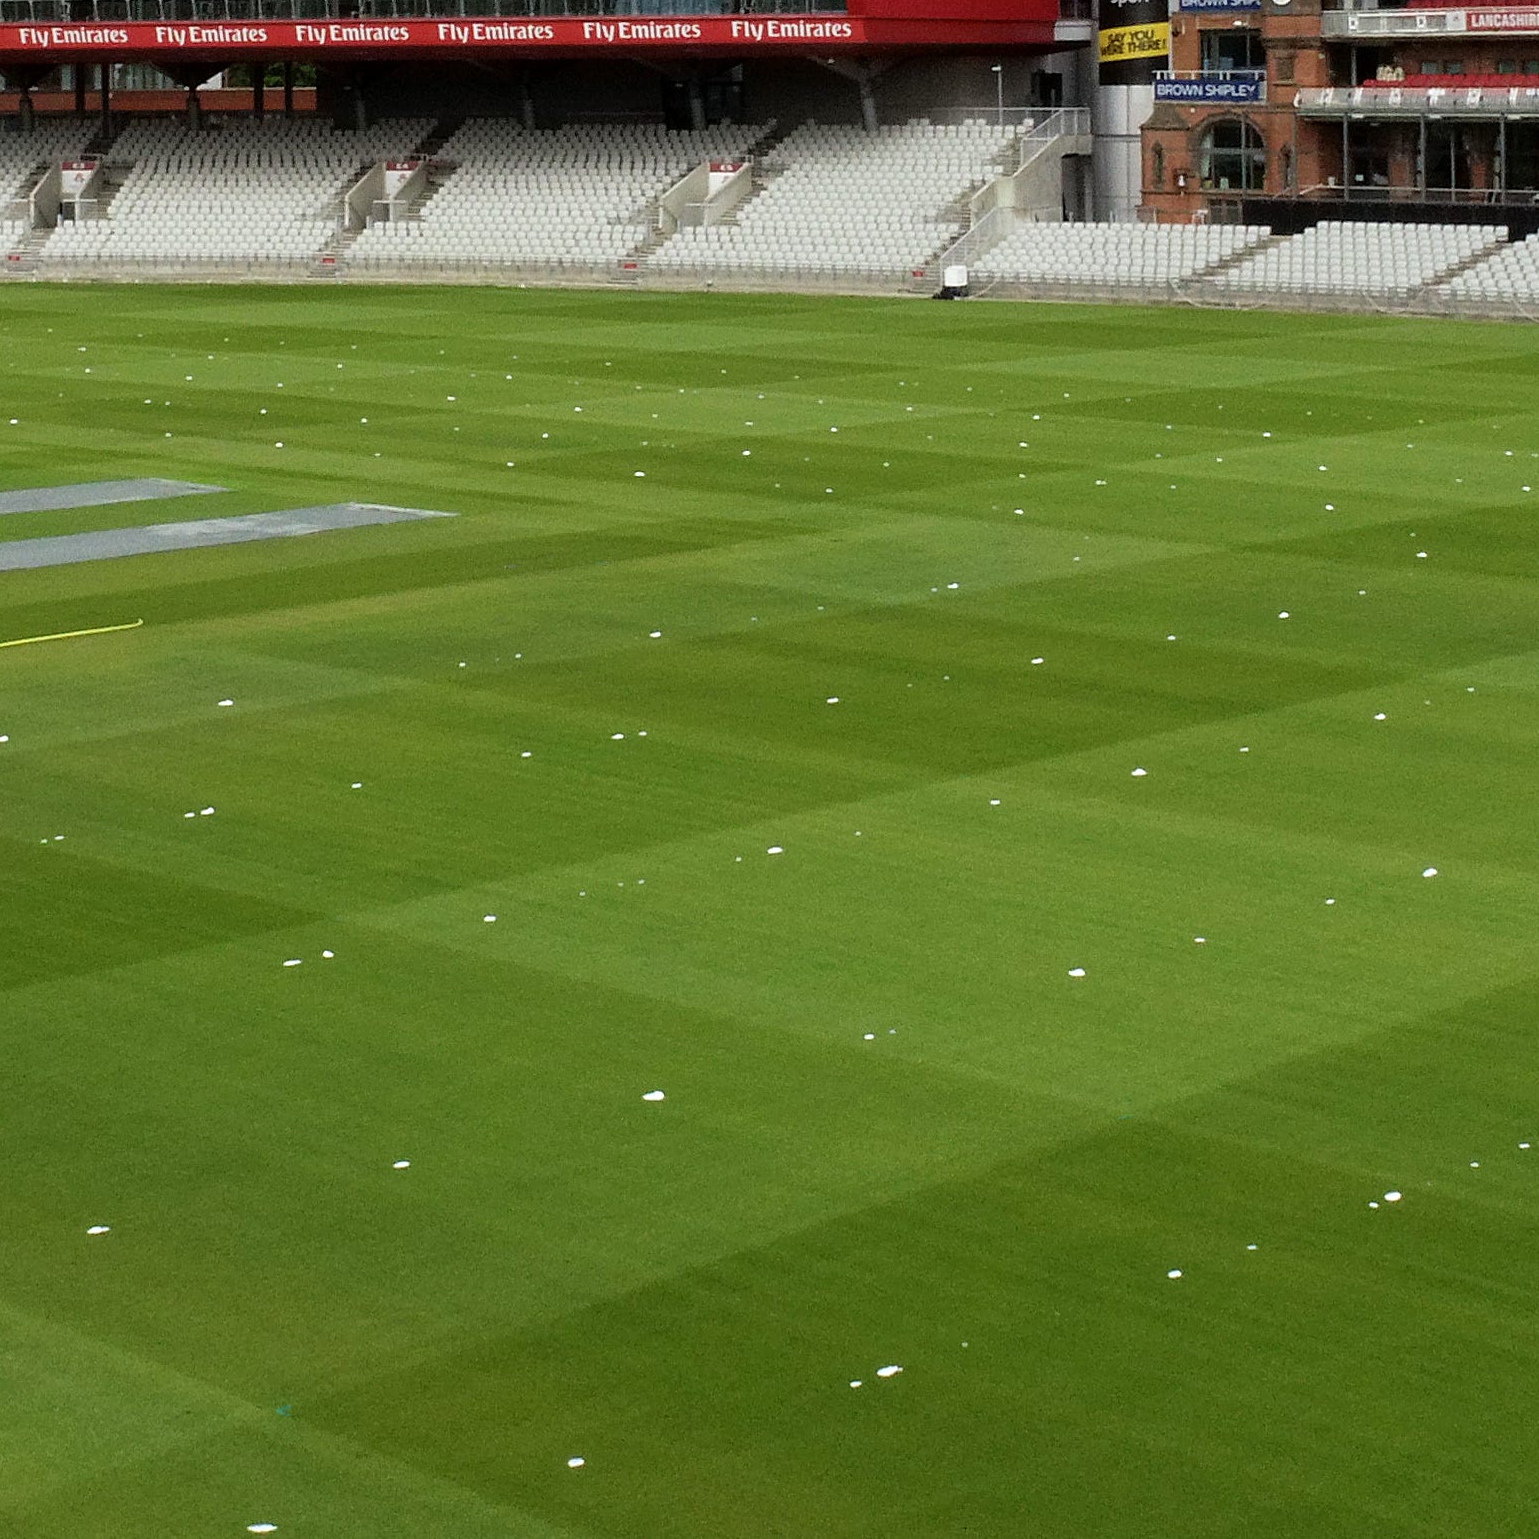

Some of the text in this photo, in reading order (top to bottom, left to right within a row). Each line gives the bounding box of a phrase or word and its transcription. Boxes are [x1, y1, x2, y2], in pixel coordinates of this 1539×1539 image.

[19, 26, 128, 47] Fly Emirates
[156, 25, 267, 46] Fly Emirates
[296, 23, 409, 44] Fly Emirates
[438, 22, 553, 43] Fly Emirates
[583, 20, 701, 41] Fly Emirates
[732, 19, 851, 40] Fly Emirates
[1130, 30, 1154, 41] YOU
[1157, 84, 1255, 96] BROWN SHIPLEY
